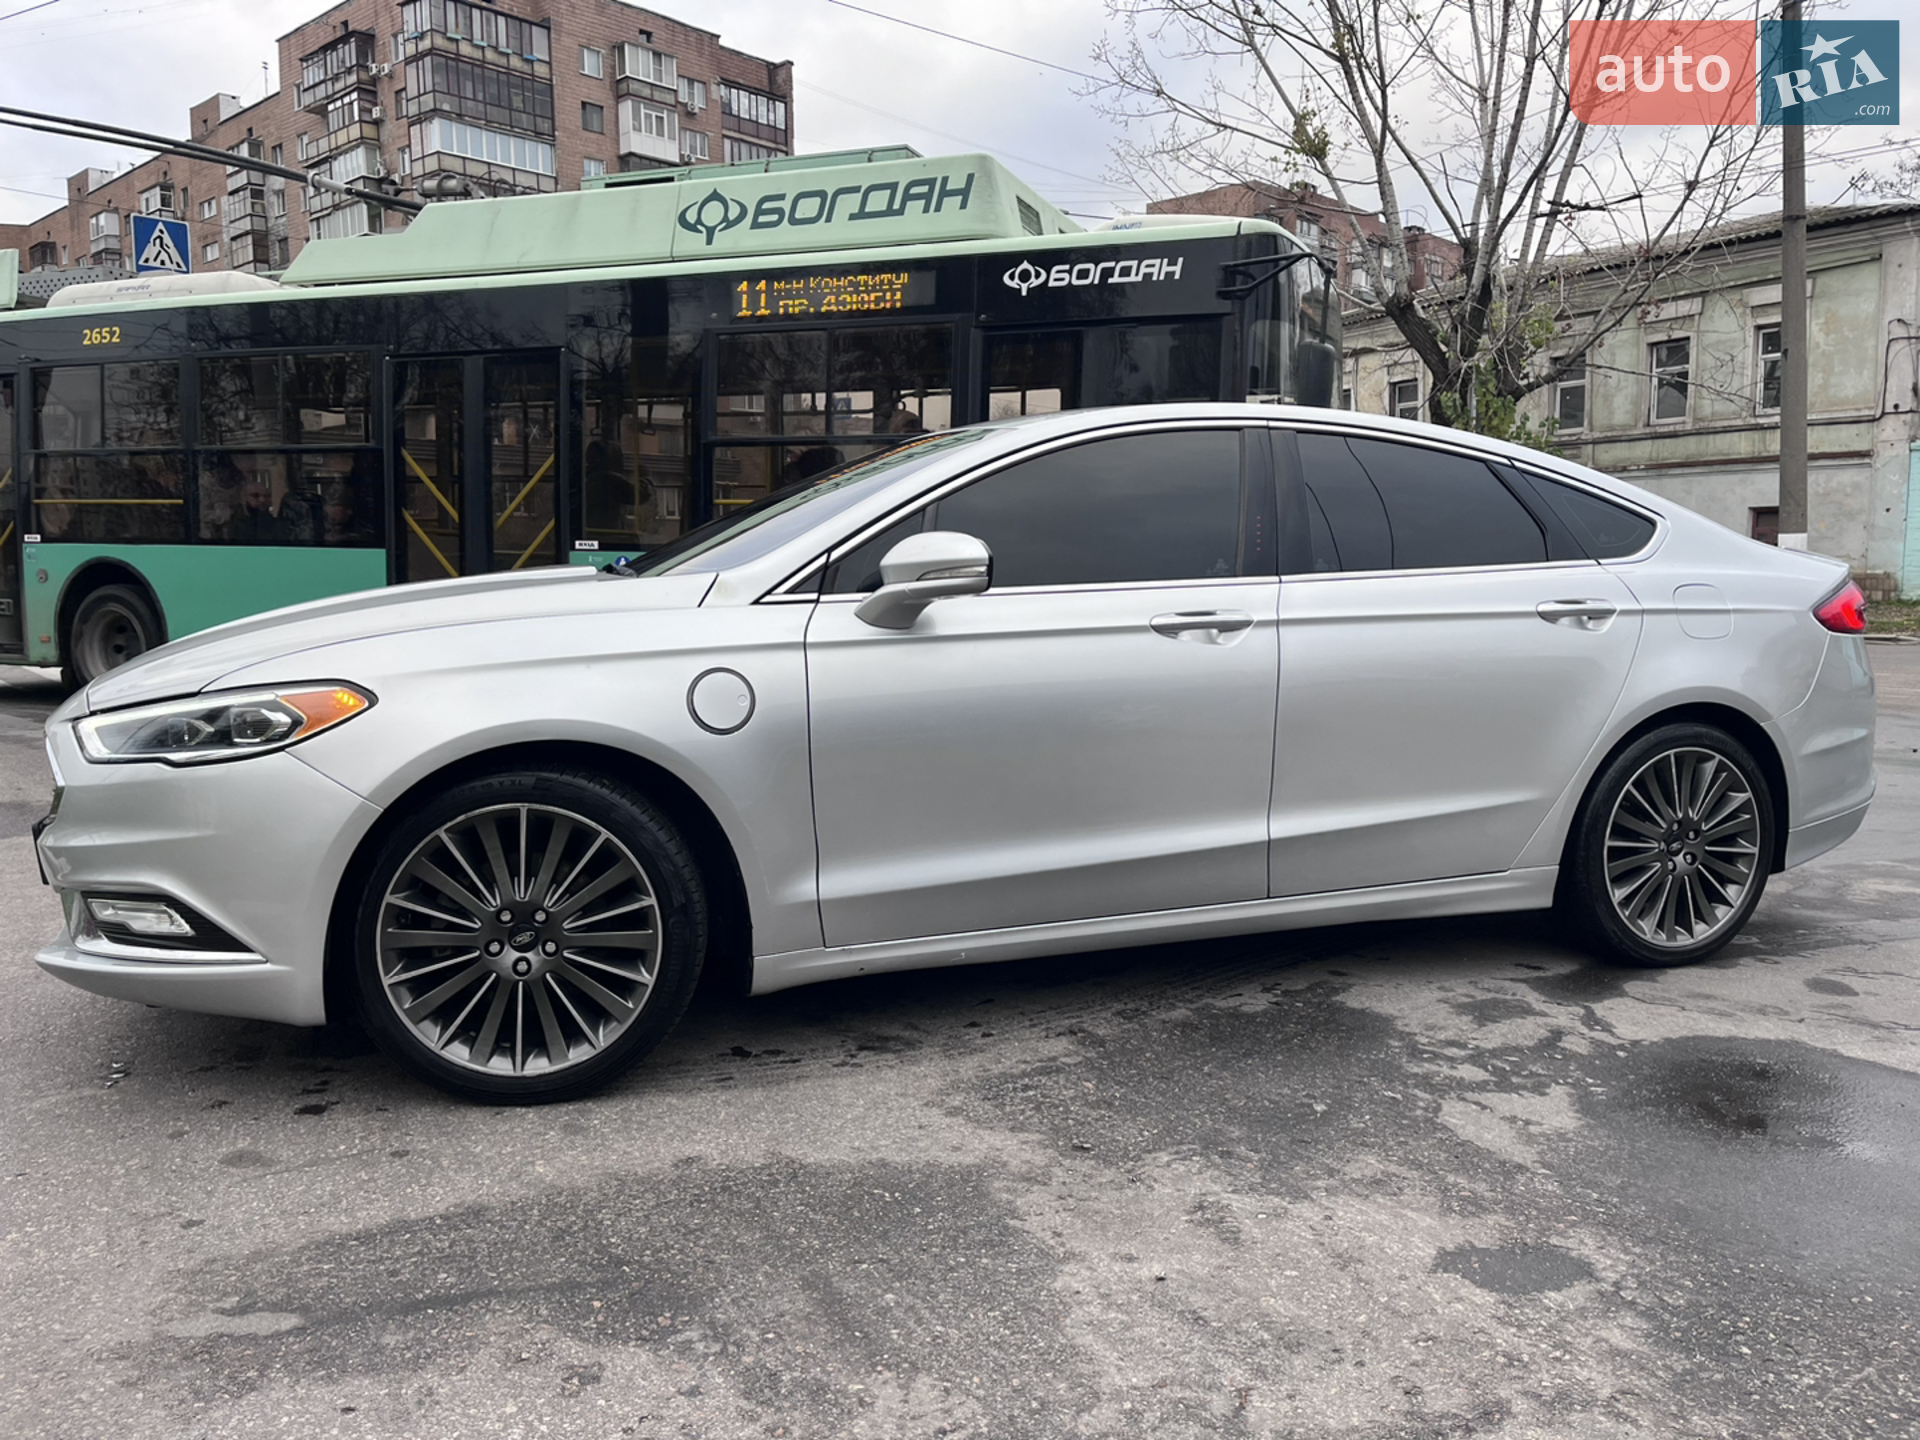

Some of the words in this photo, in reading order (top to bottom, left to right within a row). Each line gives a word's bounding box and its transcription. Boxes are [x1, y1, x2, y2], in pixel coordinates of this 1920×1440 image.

[749, 172, 976, 230] БОГДАН
[1048, 256, 1184, 288] БОГДАН
[736, 279, 771, 317] 11
[82, 326, 121, 345] 2652
